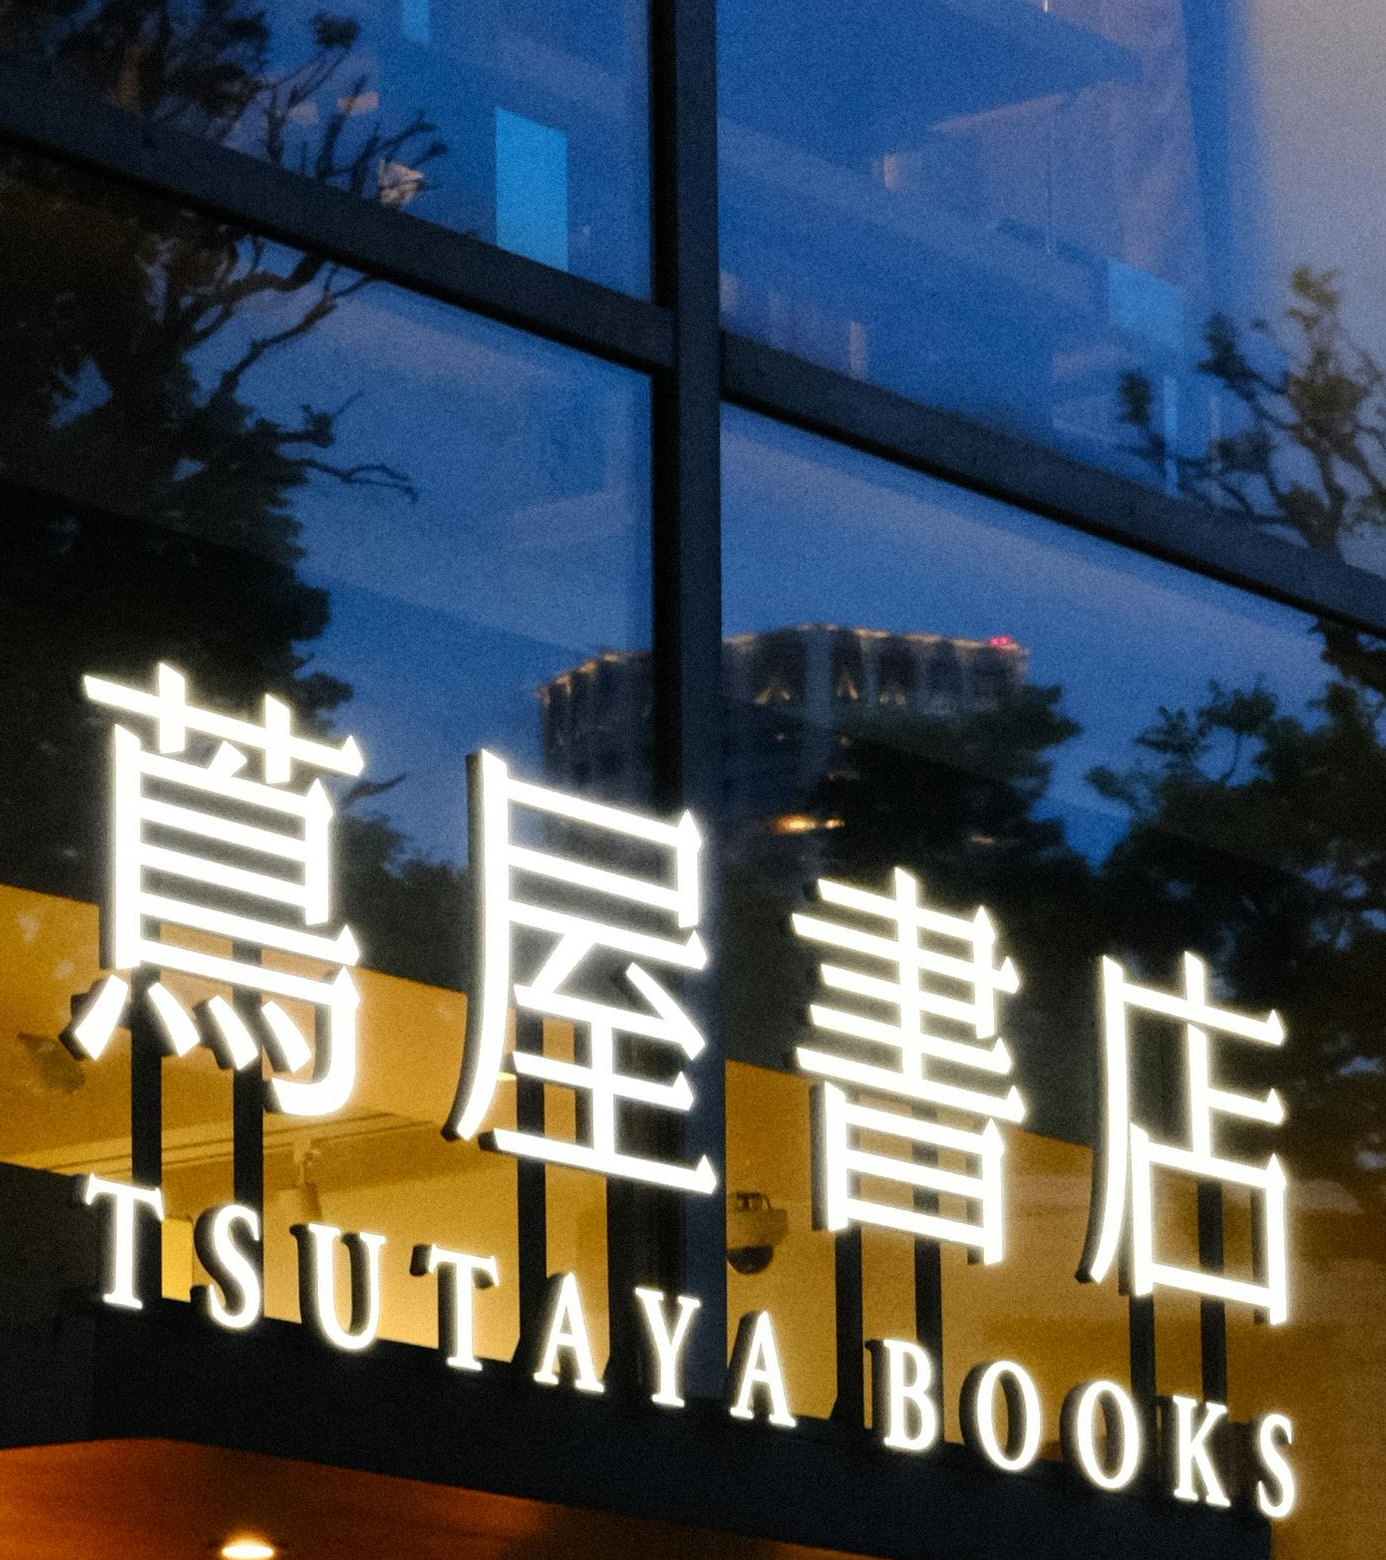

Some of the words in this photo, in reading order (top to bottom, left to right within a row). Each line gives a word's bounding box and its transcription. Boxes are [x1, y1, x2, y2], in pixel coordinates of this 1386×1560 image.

[65, 661, 1292, 1326] 蔦屋書店
[81, 1172, 798, 1430] TSUTAYA
[879, 1336, 1298, 1520] BOOKS
